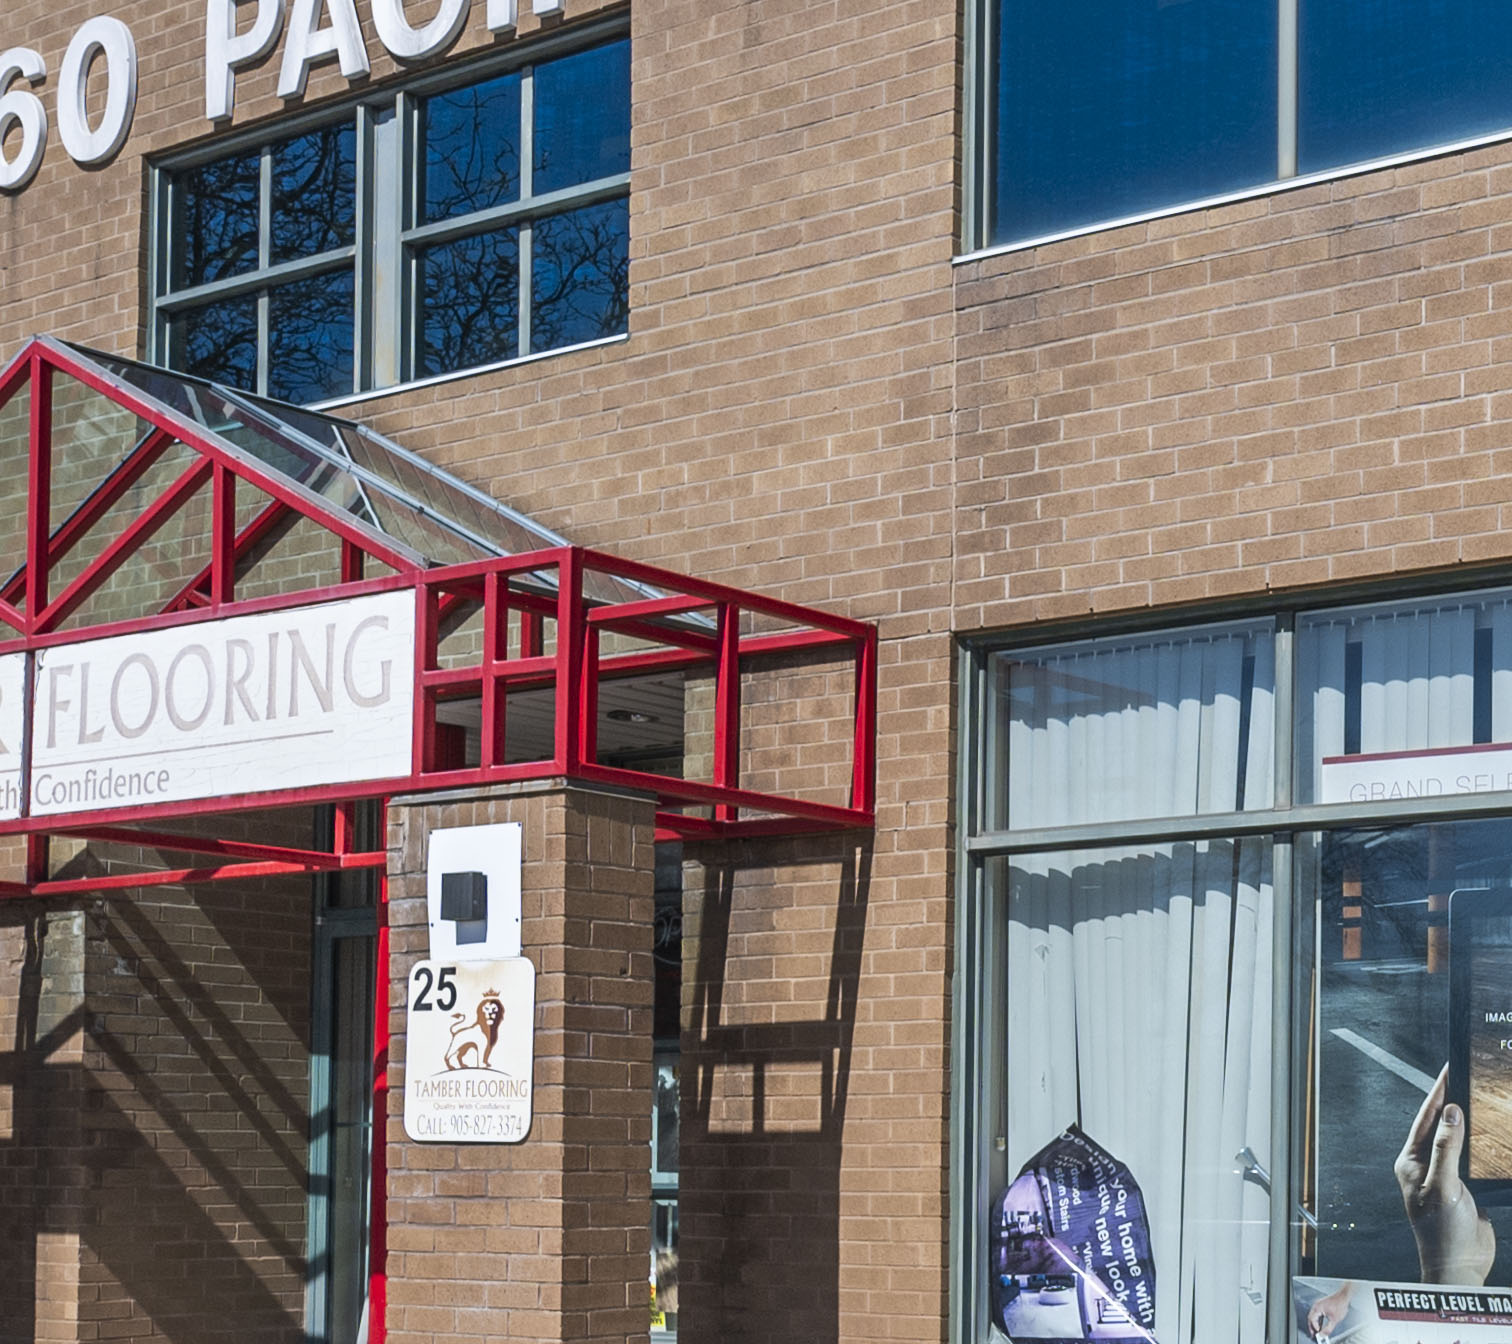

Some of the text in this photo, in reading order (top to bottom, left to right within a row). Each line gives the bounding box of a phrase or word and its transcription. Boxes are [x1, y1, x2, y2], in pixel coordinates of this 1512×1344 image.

[45, 614, 392, 750] FLOORING
[35, 767, 171, 806] Confidence
[413, 966, 457, 1012] 25
[414, 1078, 528, 1098] TAMBER FLOORING
[449, 1114, 523, 1136] 905-827-3374
[1059, 1197, 1070, 1232] Stairs
[1109, 1177, 1128, 1219] your
[1088, 1156, 1130, 1303] unique new look
[1118, 1221, 1142, 1277] home
[1135, 1280, 1155, 1324] with
[1377, 1291, 1436, 1310] PERFECT
[1439, 1294, 1485, 1312] LEVEL
